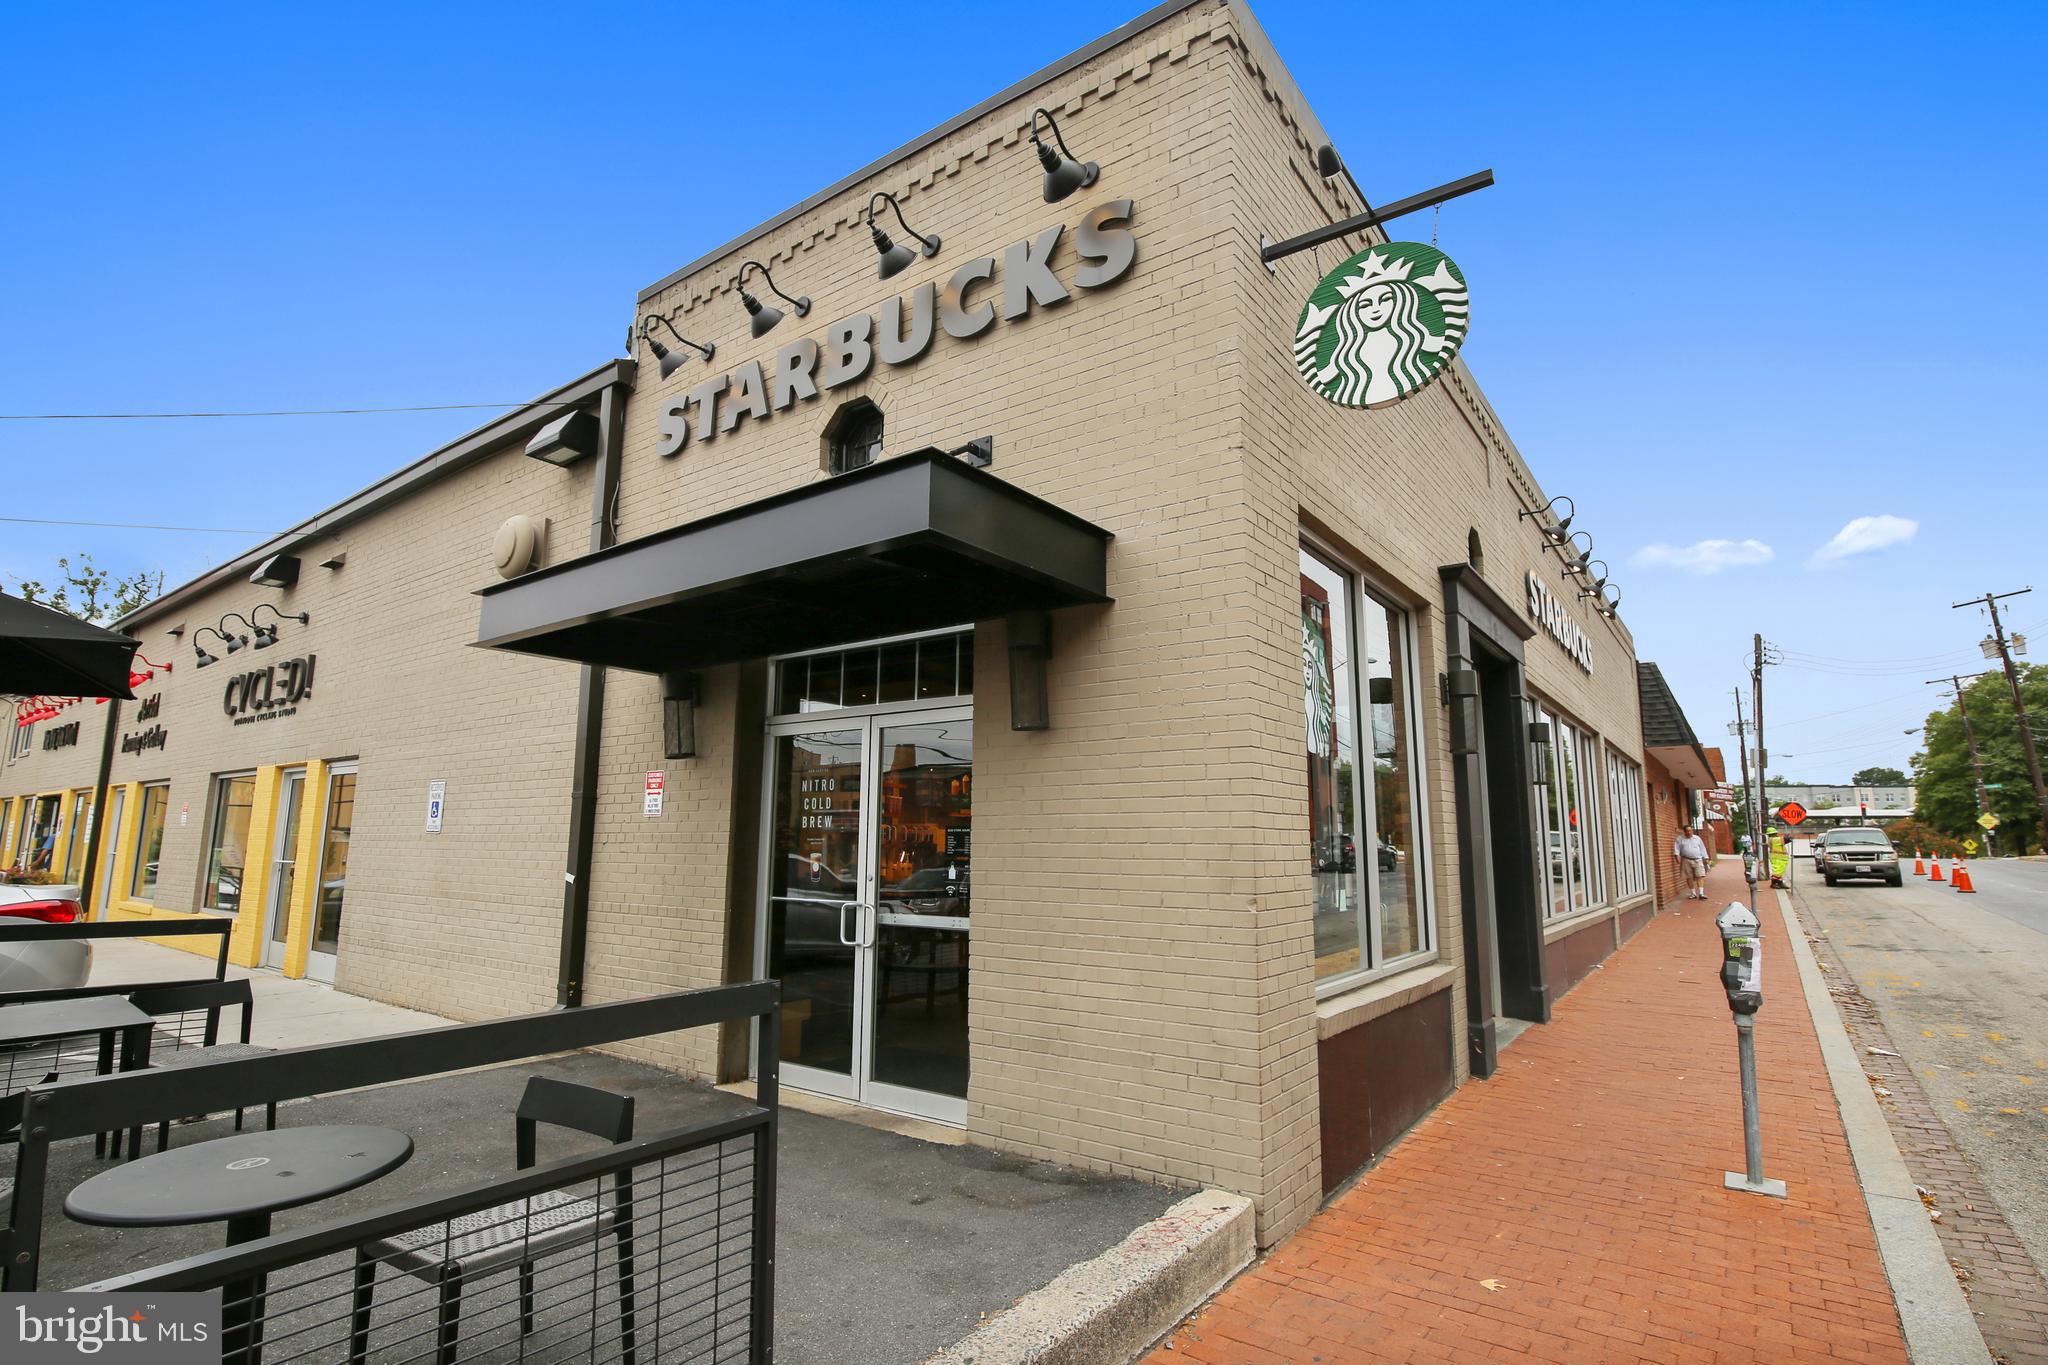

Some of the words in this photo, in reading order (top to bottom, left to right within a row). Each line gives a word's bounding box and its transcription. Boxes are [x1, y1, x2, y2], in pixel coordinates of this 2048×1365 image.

[655, 199, 1136, 458] STARBUCKS
[1527, 567, 1594, 675] STARBUCKS
[224, 654, 316, 716] CYCLED!
[801, 778, 836, 793] NITRO
[803, 796, 832, 810] COLD
[1782, 808, 1804, 819] SLOW
[801, 815, 833, 829] BREW
